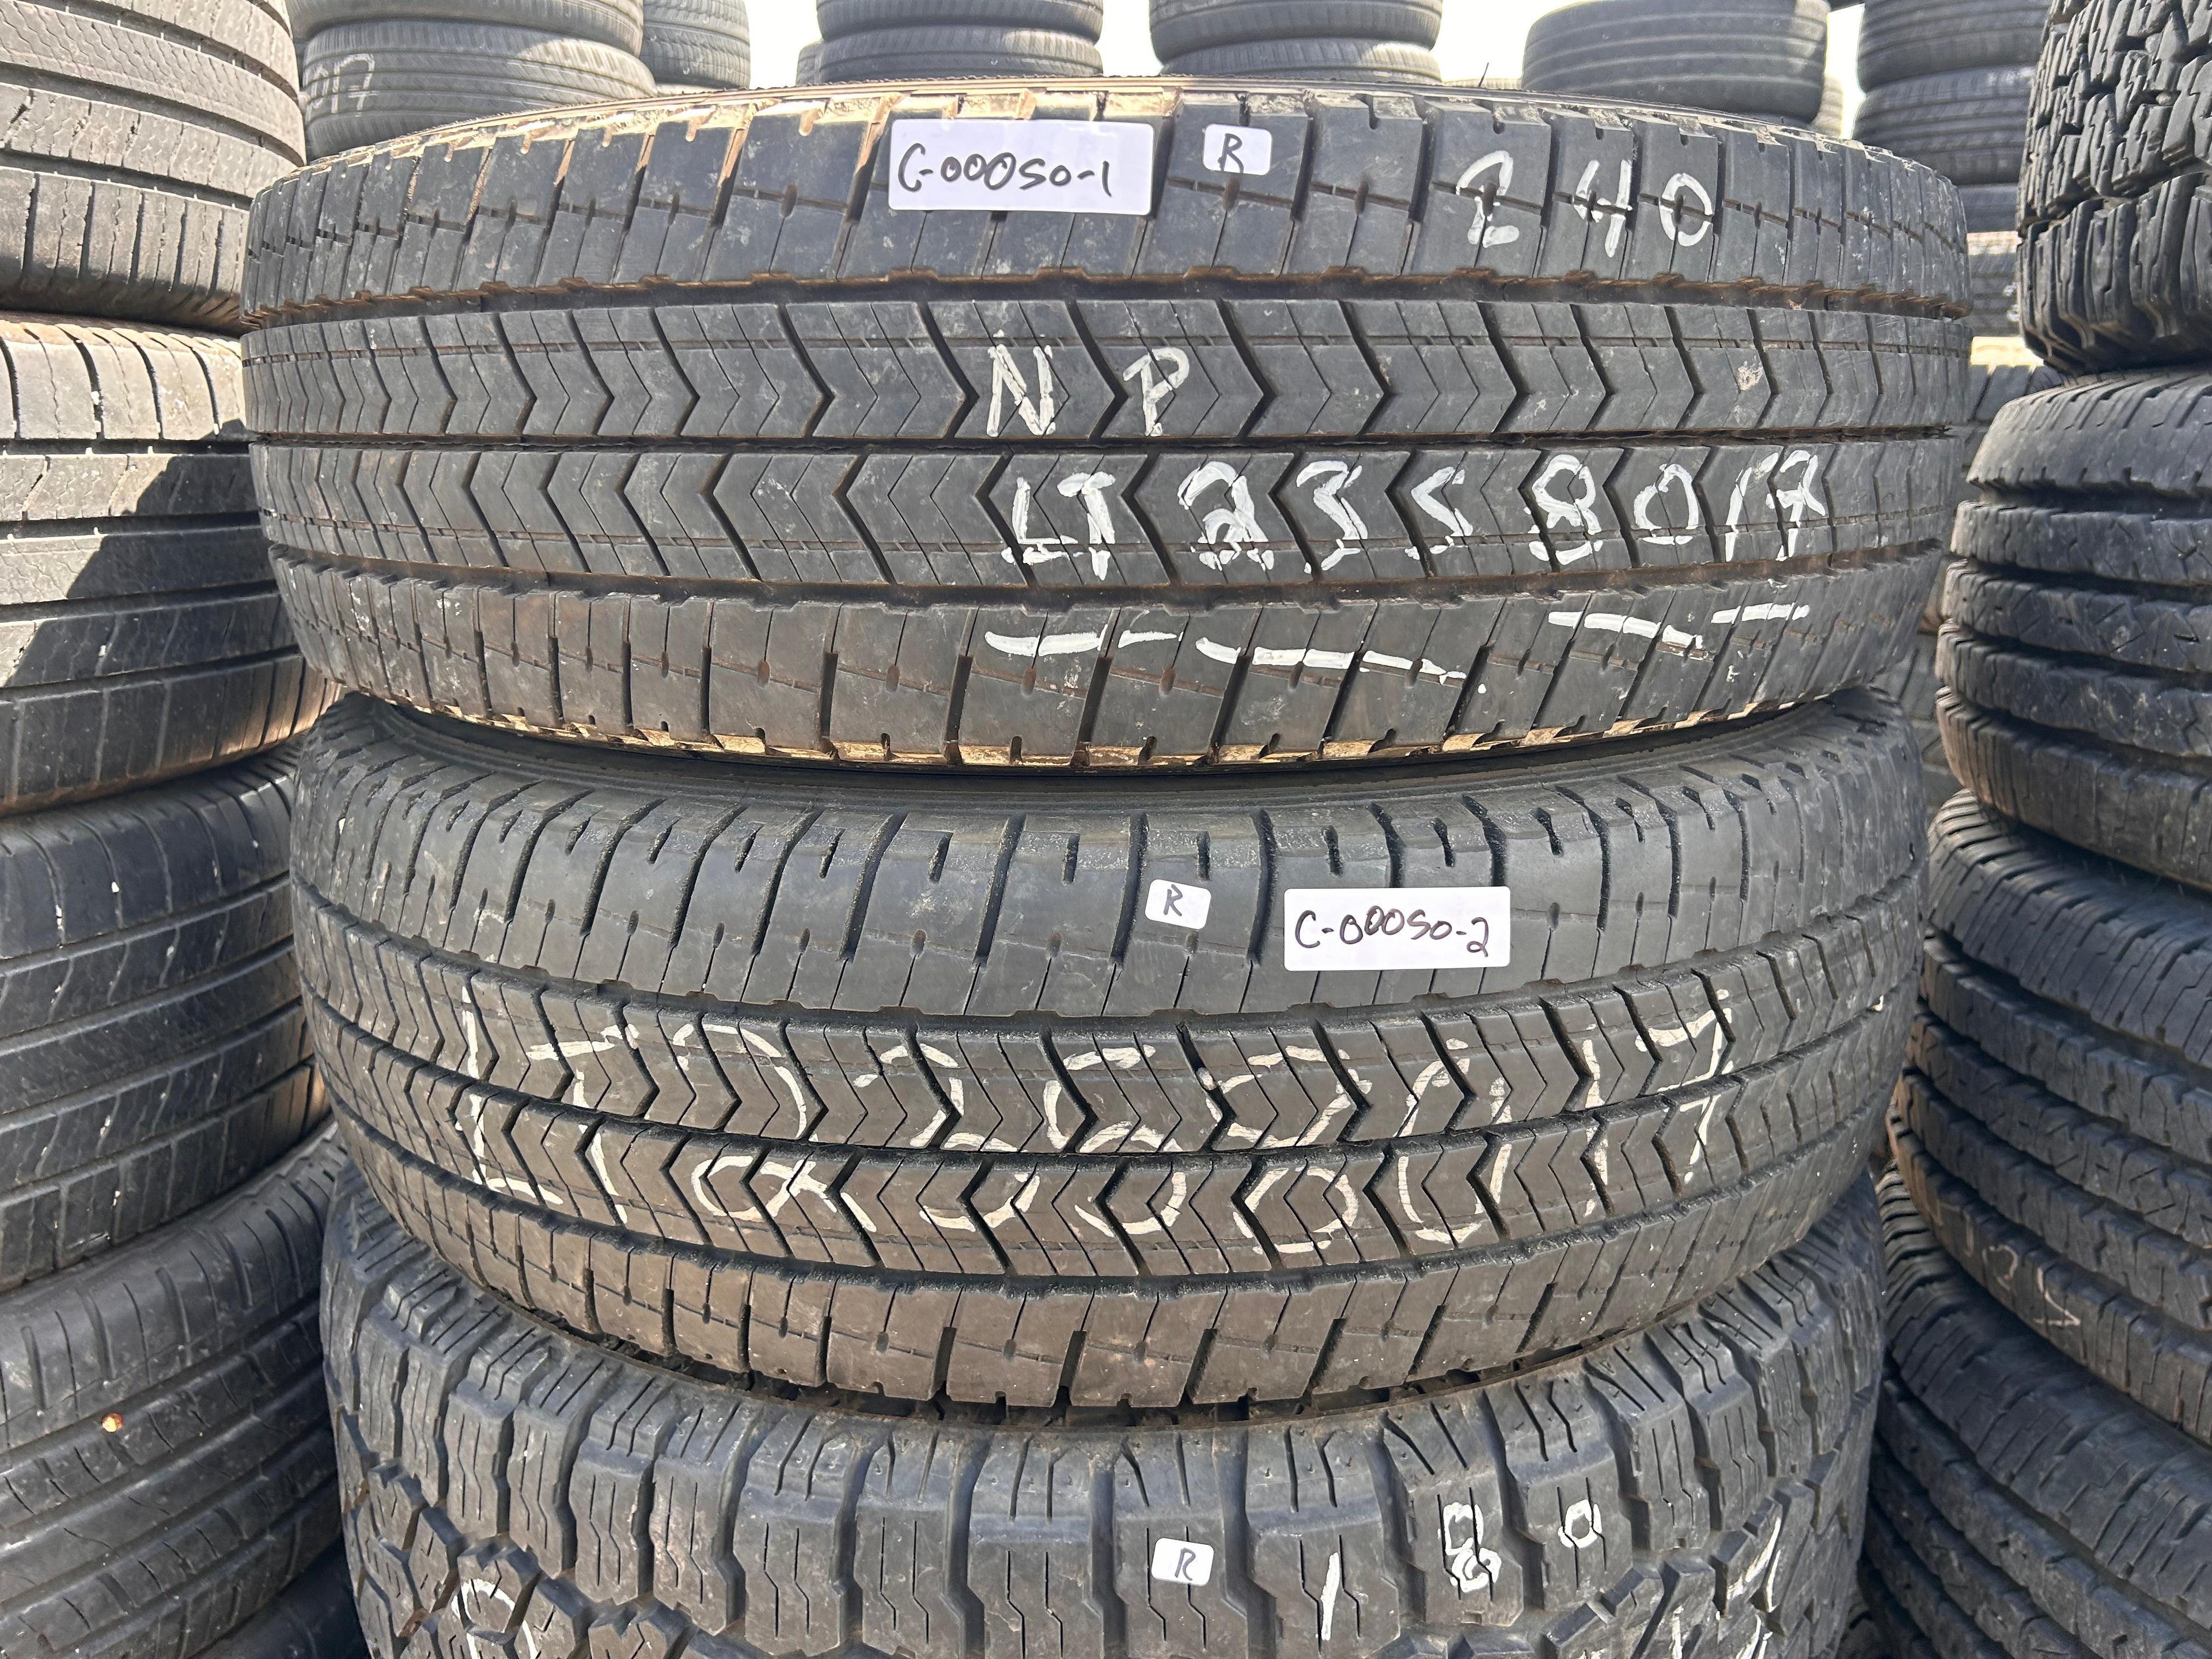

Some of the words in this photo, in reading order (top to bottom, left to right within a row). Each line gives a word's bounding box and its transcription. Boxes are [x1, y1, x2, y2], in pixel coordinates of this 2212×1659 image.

[1217, 132, 1244, 173] R
[1163, 885, 1183, 916] R
[1174, 1548, 1197, 1581] R
